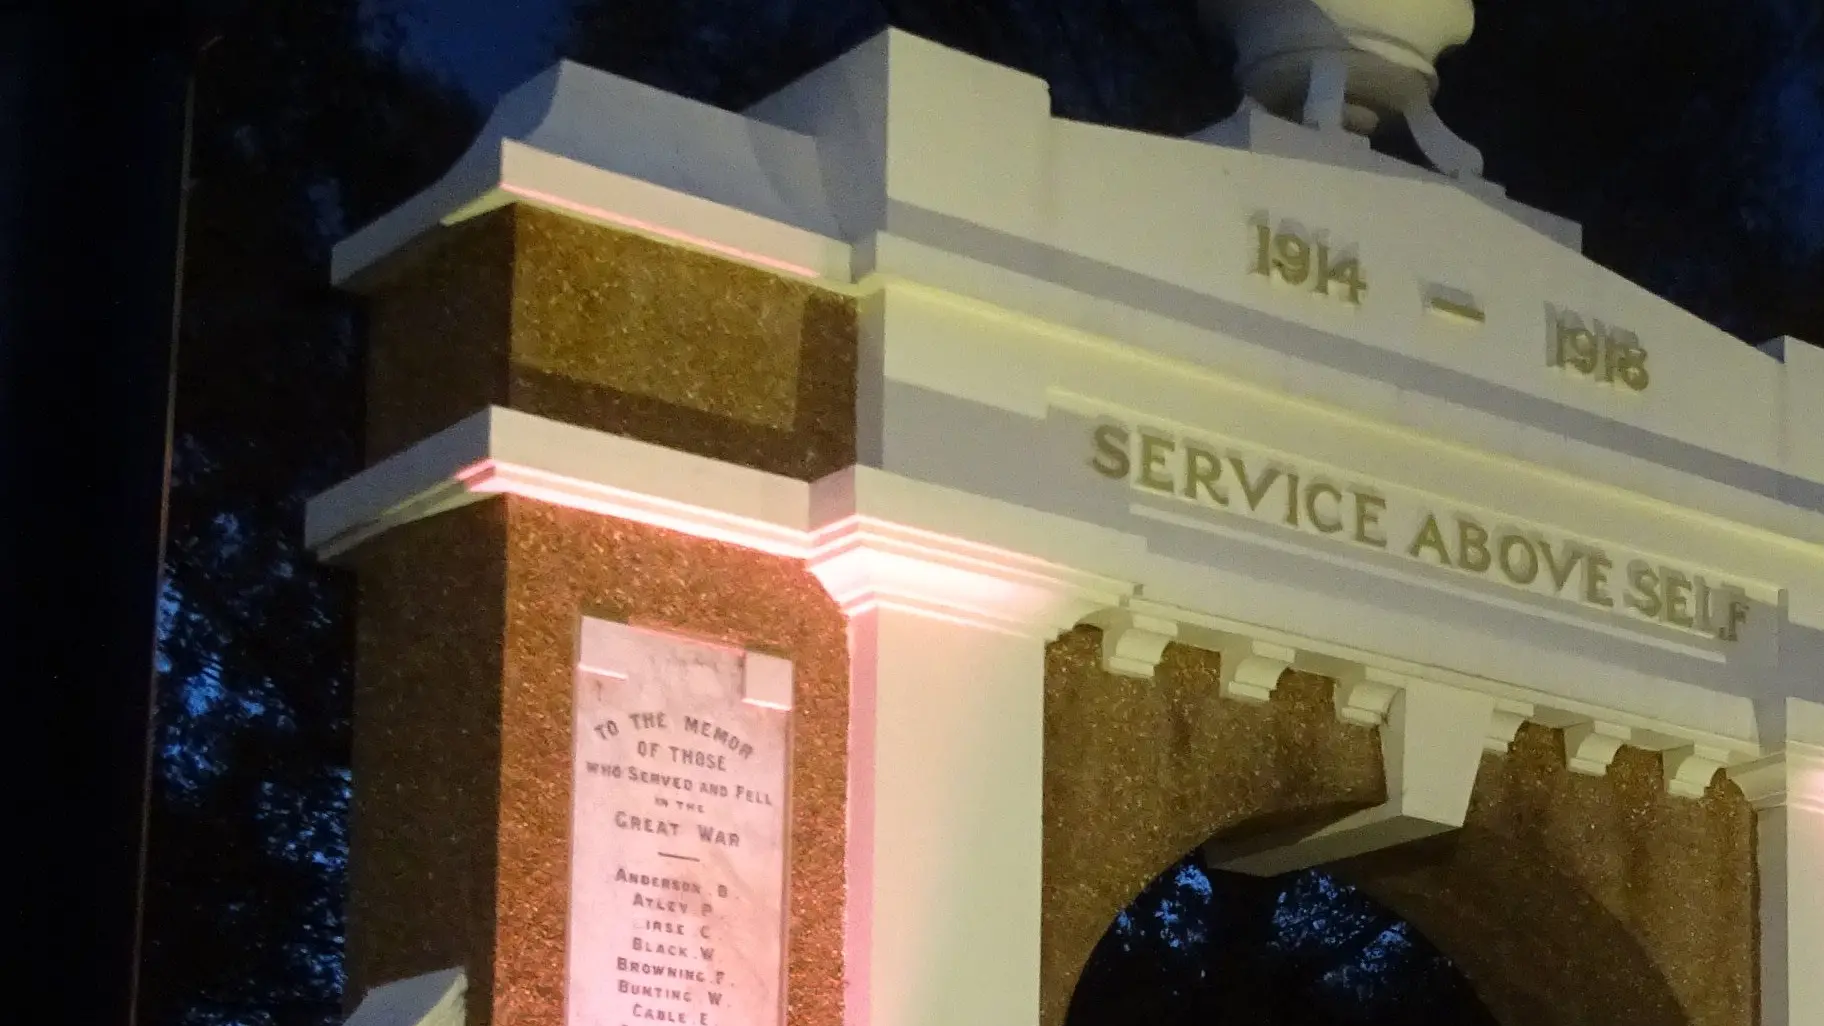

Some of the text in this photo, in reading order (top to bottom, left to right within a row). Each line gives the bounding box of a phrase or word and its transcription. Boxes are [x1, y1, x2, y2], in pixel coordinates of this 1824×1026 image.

[1252, 220, 1367, 304] 1914
[1555, 314, 1650, 392] 1918
[1092, 423, 1751, 643] SERVICE ABOVE SELF
[594, 711, 754, 760] TO THE MEMOR
[637, 740, 728, 772] OF THOSE
[585, 760, 773, 807] WHO SERVED AND FELL
[655, 797, 705, 814] IN THE
[614, 810, 741, 848] GREAT WAR
[632, 891, 689, 914] ATLEY
[617, 979, 693, 1003] BUNTING
[632, 1002, 687, 1024] CABLE
